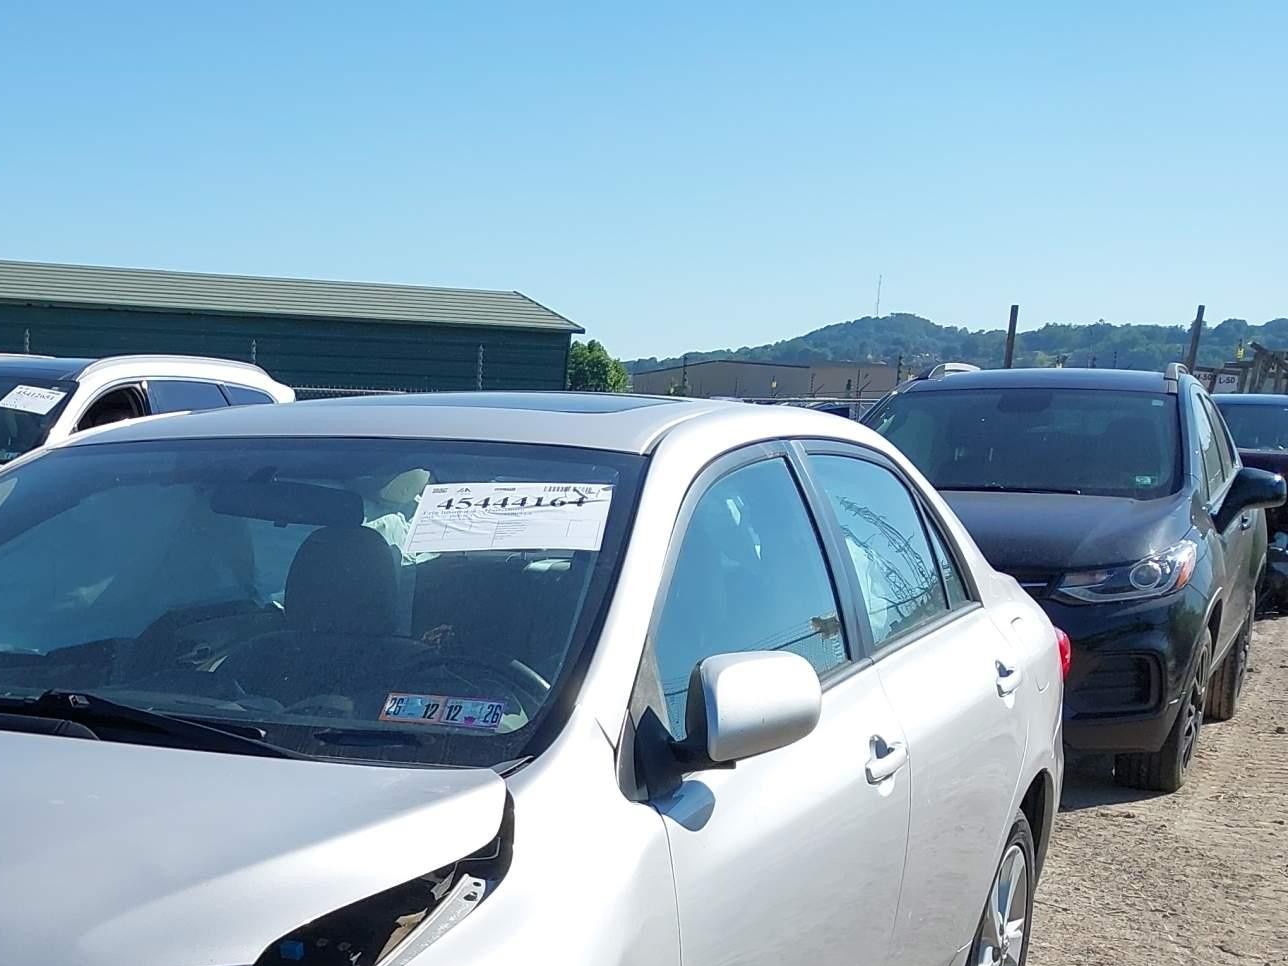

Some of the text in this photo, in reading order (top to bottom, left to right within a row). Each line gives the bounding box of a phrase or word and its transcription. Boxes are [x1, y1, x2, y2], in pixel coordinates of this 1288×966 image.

[437, 496, 589, 510] 45444164
[385, 698, 440, 720] 26 12
[445, 704, 503, 724] 12 26
